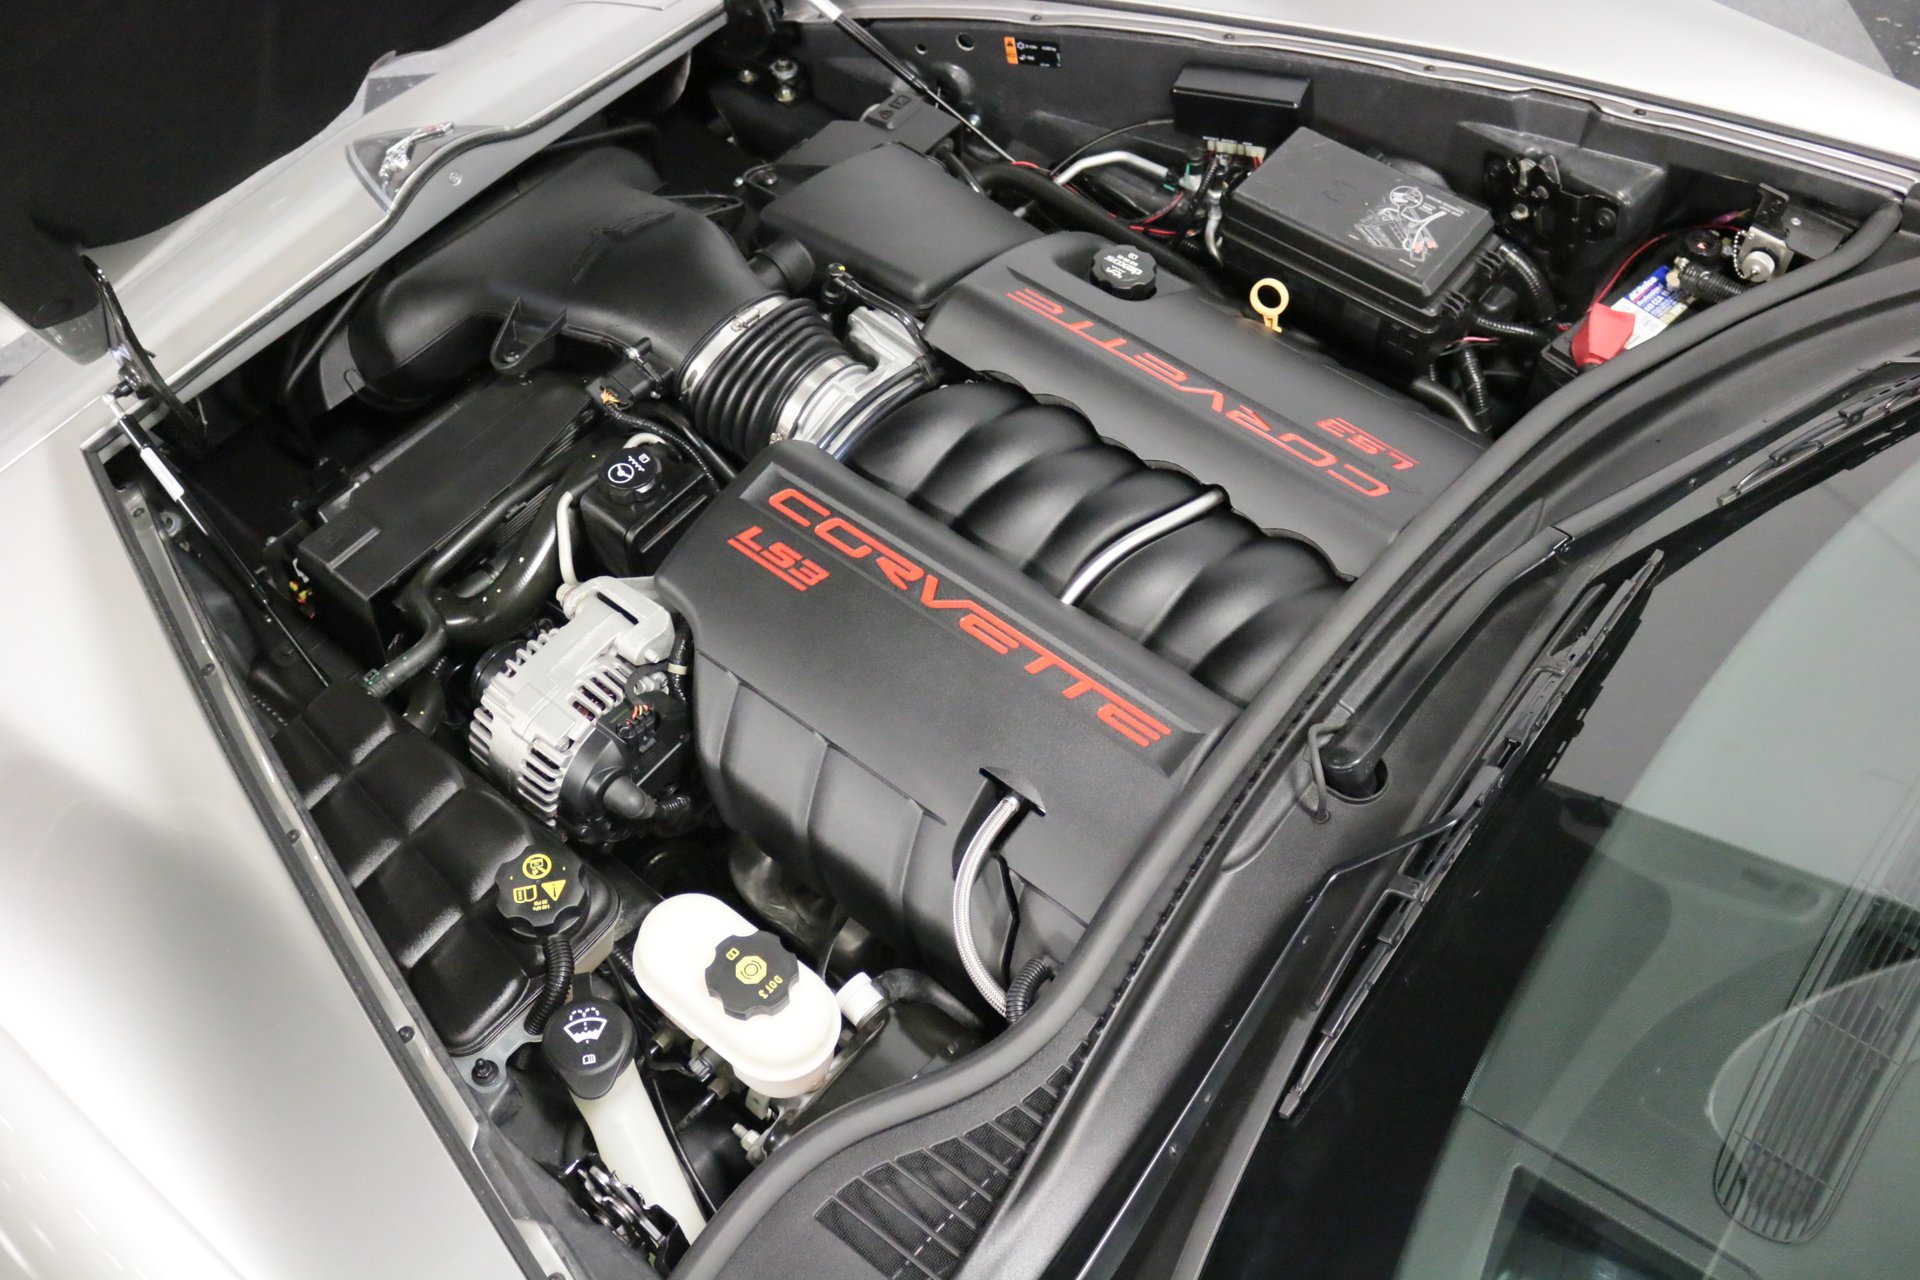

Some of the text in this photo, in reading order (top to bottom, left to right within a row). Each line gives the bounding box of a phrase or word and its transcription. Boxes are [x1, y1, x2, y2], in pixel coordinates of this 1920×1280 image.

[1007, 289, 1391, 497] CORVETTE
[1315, 417, 1419, 471] LS3
[727, 526, 830, 591] LS3
[768, 489, 1171, 747] CORVETTE
[758, 975, 783, 999] DOT 3
